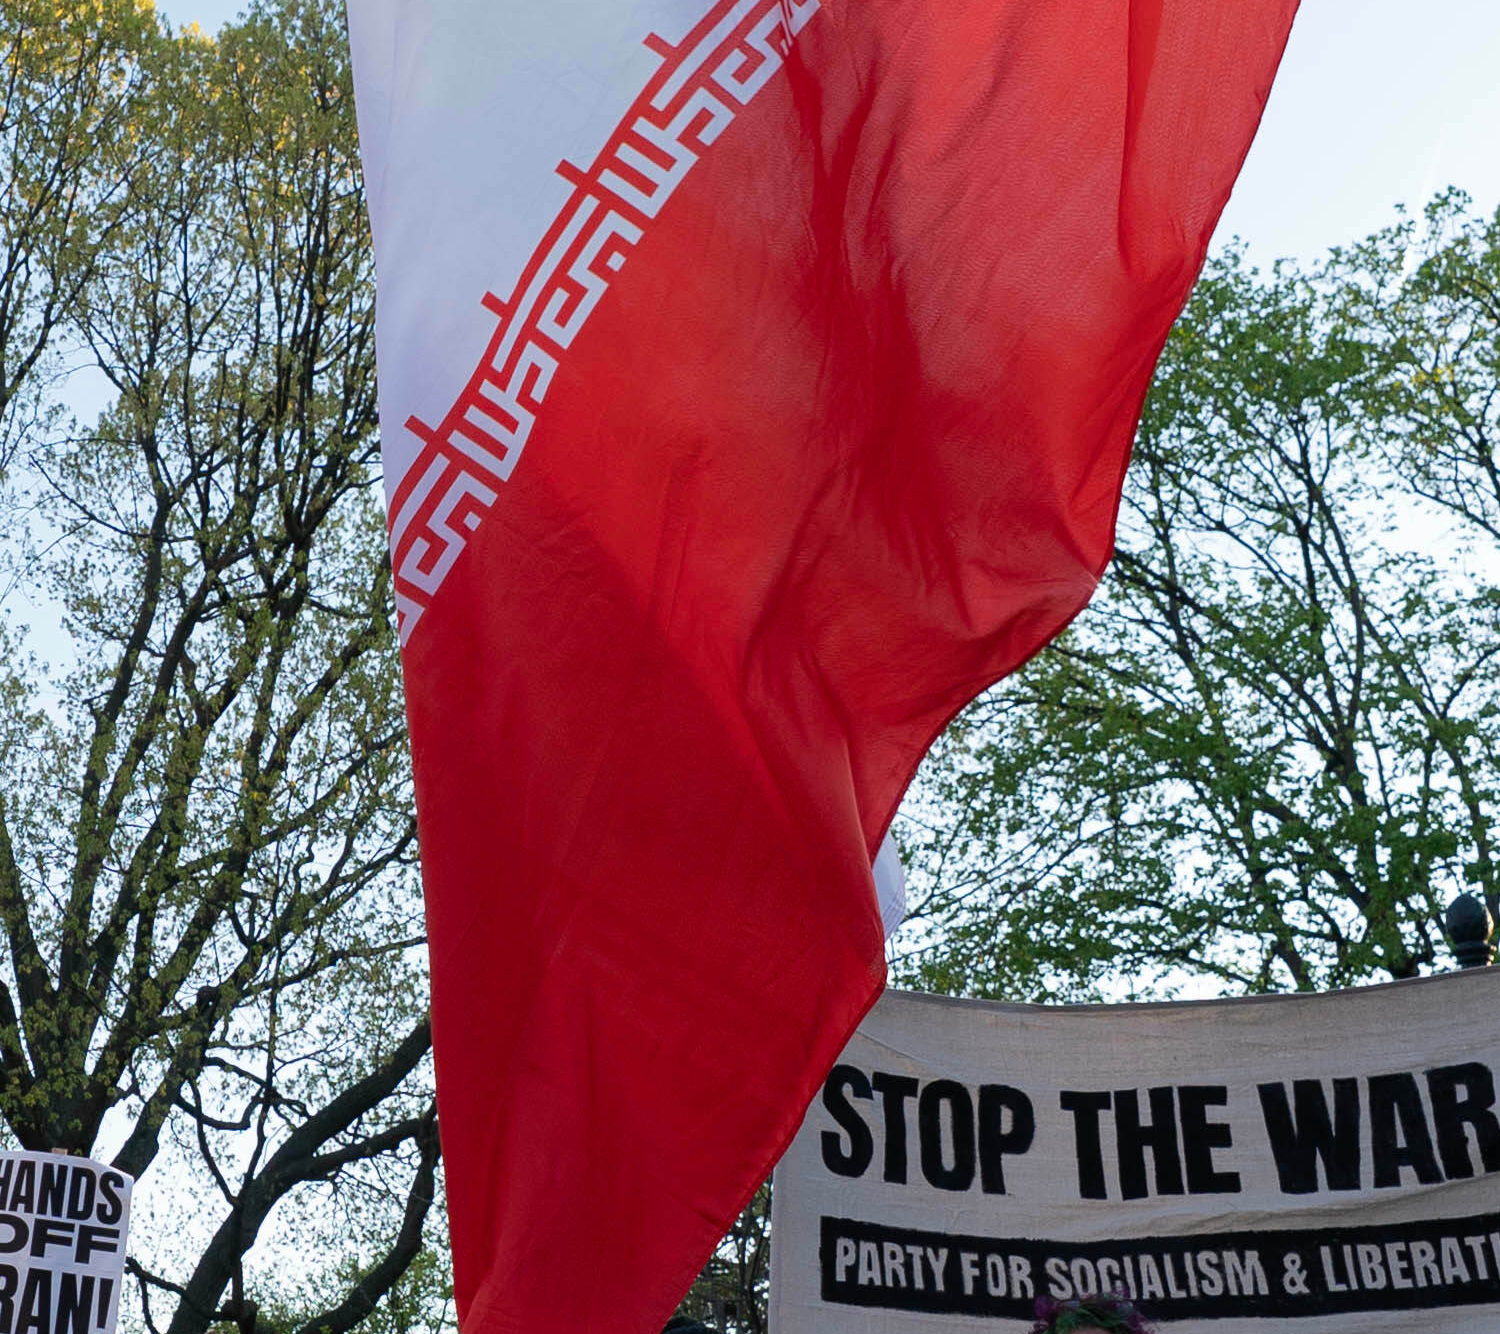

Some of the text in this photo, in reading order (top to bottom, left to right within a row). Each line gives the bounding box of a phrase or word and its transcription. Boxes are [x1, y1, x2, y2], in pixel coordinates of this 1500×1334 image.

[819, 1063, 1036, 1198] STOP
[1061, 1085, 1242, 1201] THE
[834, 1235, 949, 1293] PARTY
[960, 1246, 1036, 1301] FOR
[1046, 1247, 1268, 1305] SOCIALISM
[1283, 1250, 1310, 1293] &
